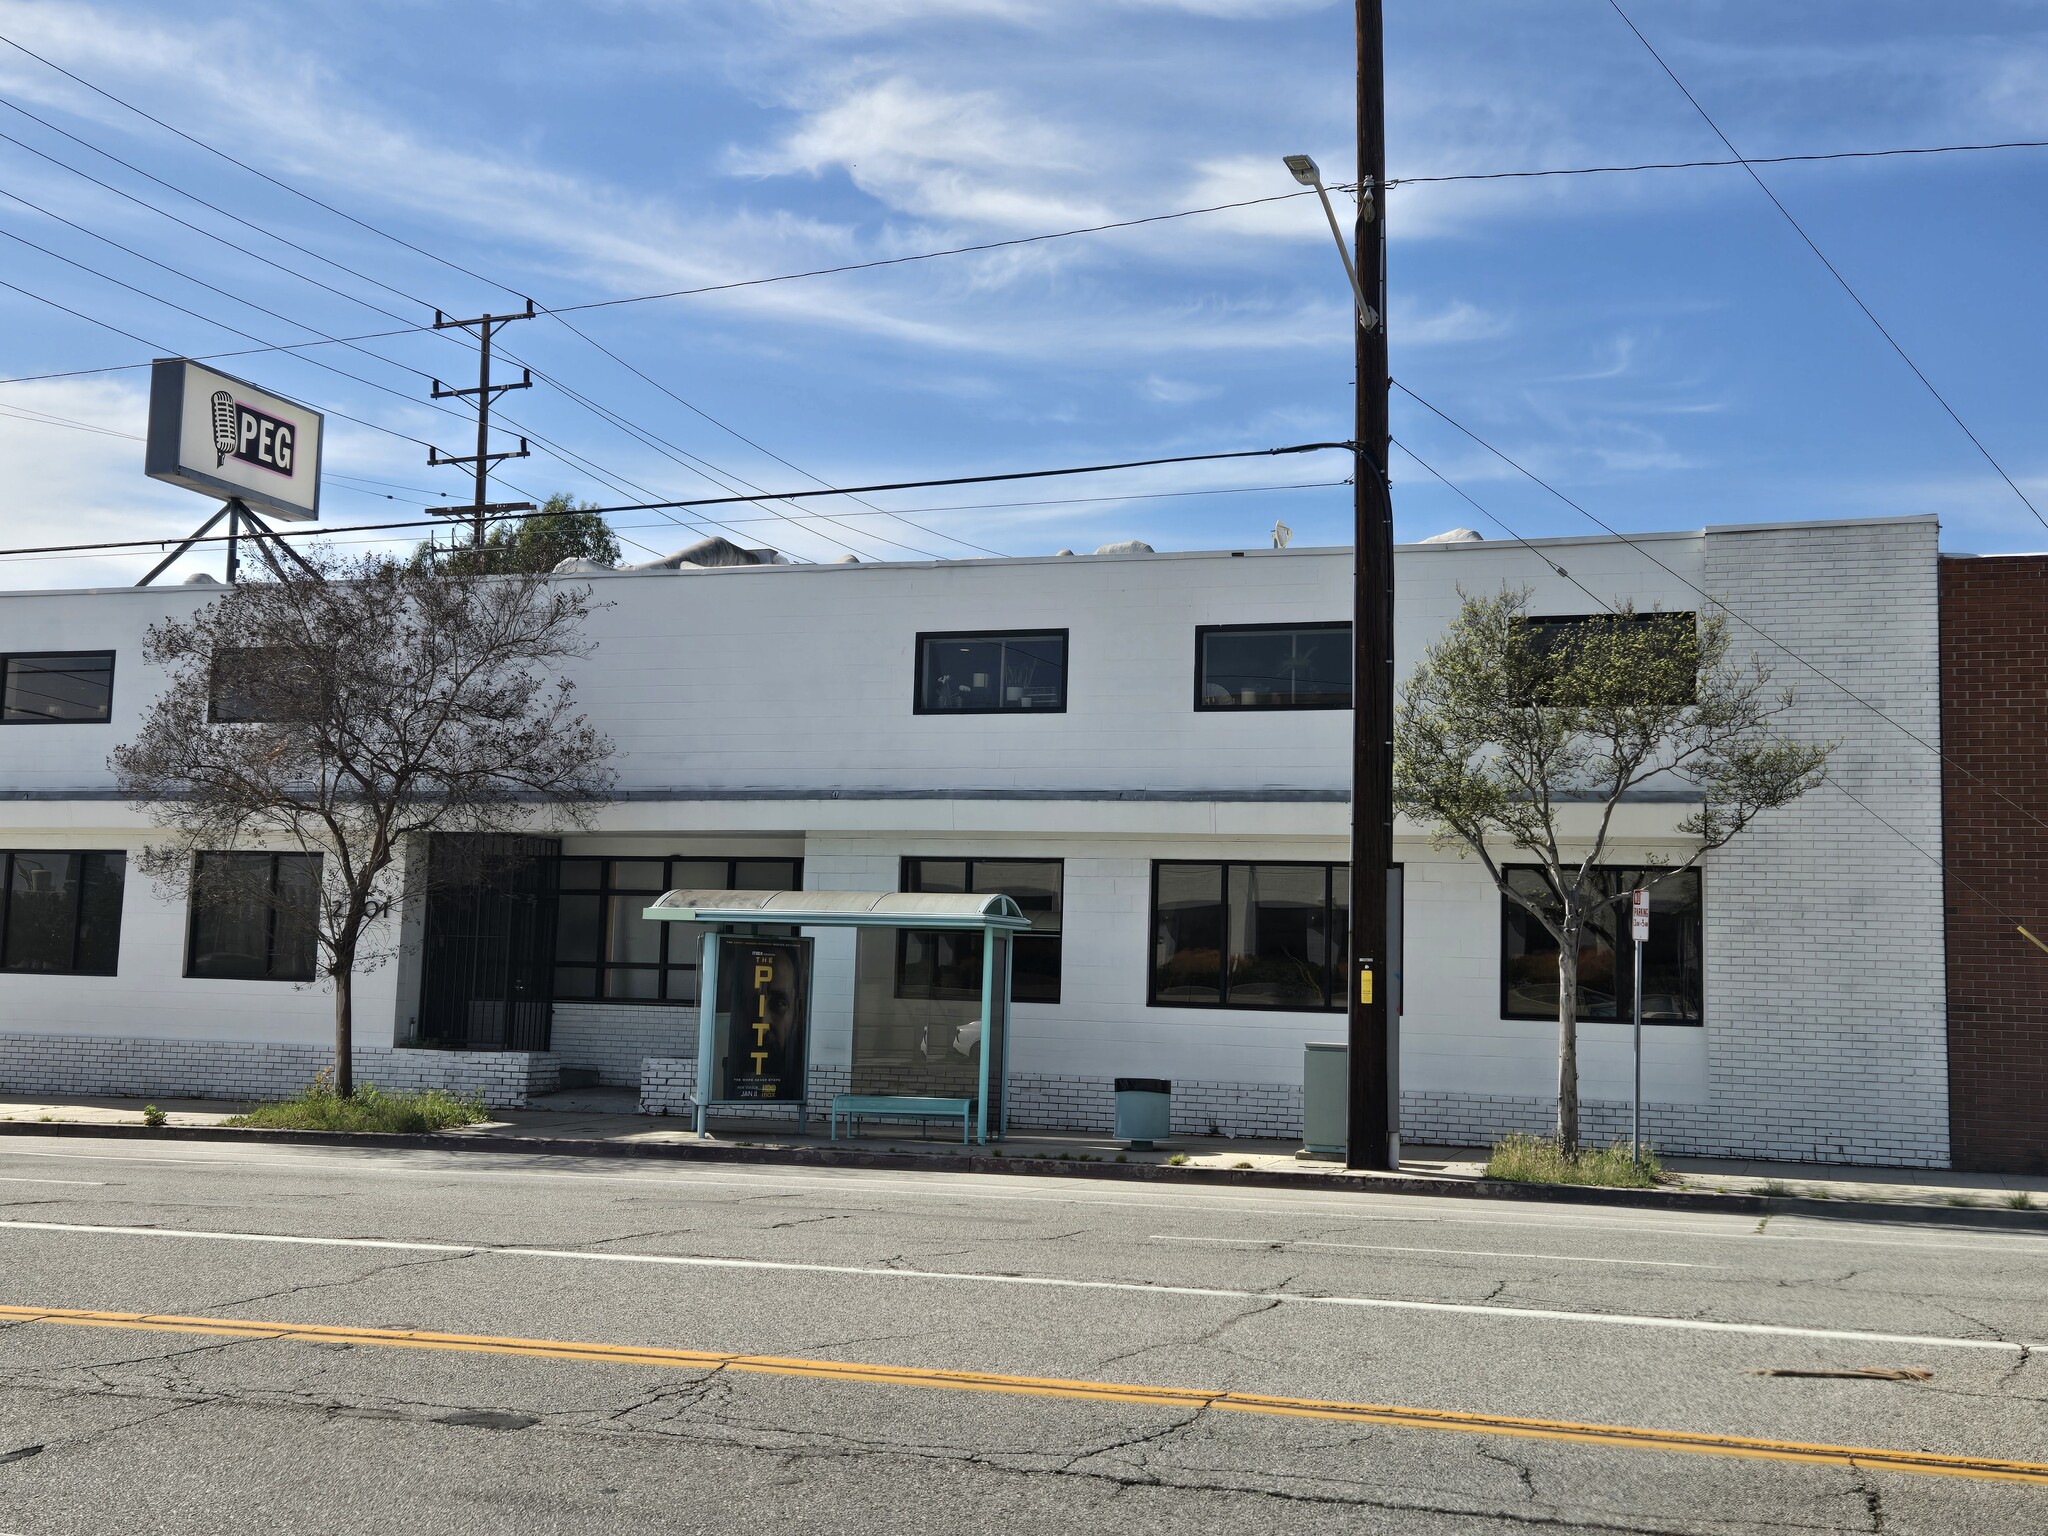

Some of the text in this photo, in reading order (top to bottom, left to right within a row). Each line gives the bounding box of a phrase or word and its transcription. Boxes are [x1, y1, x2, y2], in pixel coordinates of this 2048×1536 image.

[239, 411, 292, 470] PEG
[331, 900, 390, 919] 201
[755, 956, 773, 964] THE
[750, 965, 773, 1076] PITT
